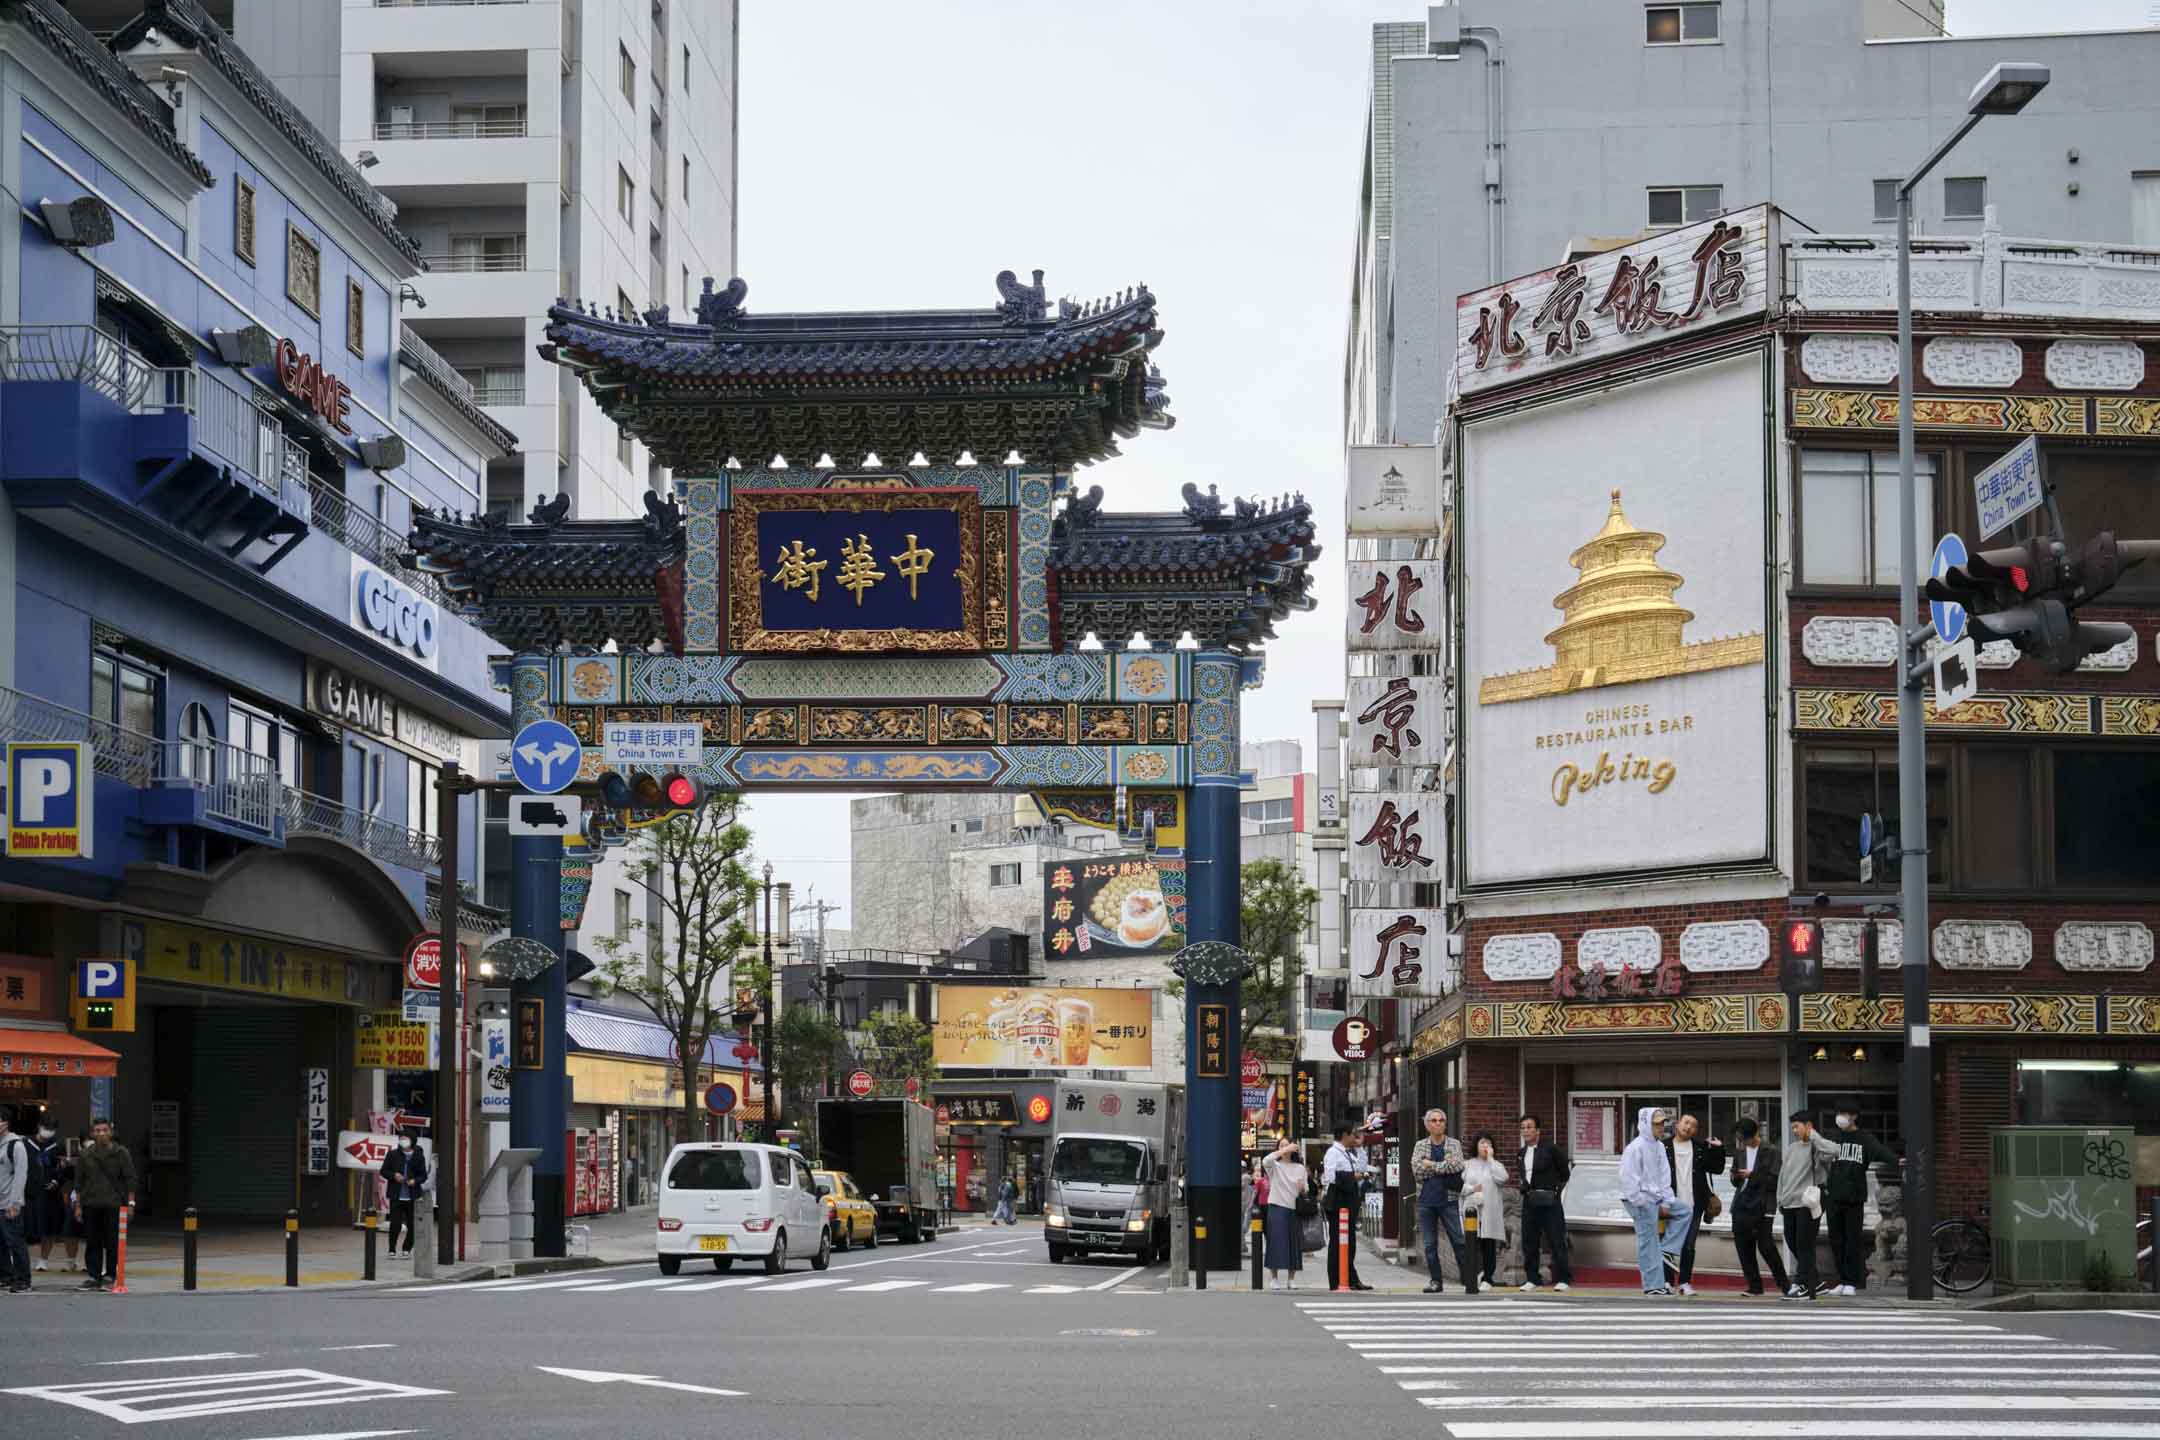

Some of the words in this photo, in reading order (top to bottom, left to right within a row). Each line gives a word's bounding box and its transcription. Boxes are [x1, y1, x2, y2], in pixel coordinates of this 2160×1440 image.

[1468, 221, 1745, 370] 北京飯店
[276, 338, 352, 436] GAME
[1979, 448, 2036, 504] 中華街東門
[1983, 506, 2004, 529] China
[2006, 491, 2026, 512] Town
[771, 532, 936, 607] 中華街
[1585, 704, 1649, 724] CHINESE
[610, 728, 696, 748] 中華街東門
[1536, 722, 1639, 749] RESTAURANT
[1643, 721, 1653, 735] &
[1660, 715, 1693, 733] BAR
[618, 749, 645, 759] China
[651, 749, 675, 759] Town
[20, 758, 71, 823] P
[1355, 565, 1435, 987] 北京飯店
[1552, 751, 1677, 807] Peking
[13, 832, 40, 849] China
[42, 832, 77, 852] Parking
[1083, 863, 1117, 878] ようこそ
[1120, 861, 1158, 877] 横浜中
[1051, 868, 1075, 952] 王府井
[87, 962, 117, 997] P
[416, 953, 441, 972] 消火
[1022, 1036, 1054, 1046] 一番搾り
[1096, 1026, 1146, 1040] 一番搾り
[310, 1070, 327, 1141] ハイルーフ車
[1065, 1093, 1086, 1111] 新
[356, 1143, 390, 1161] 入口
